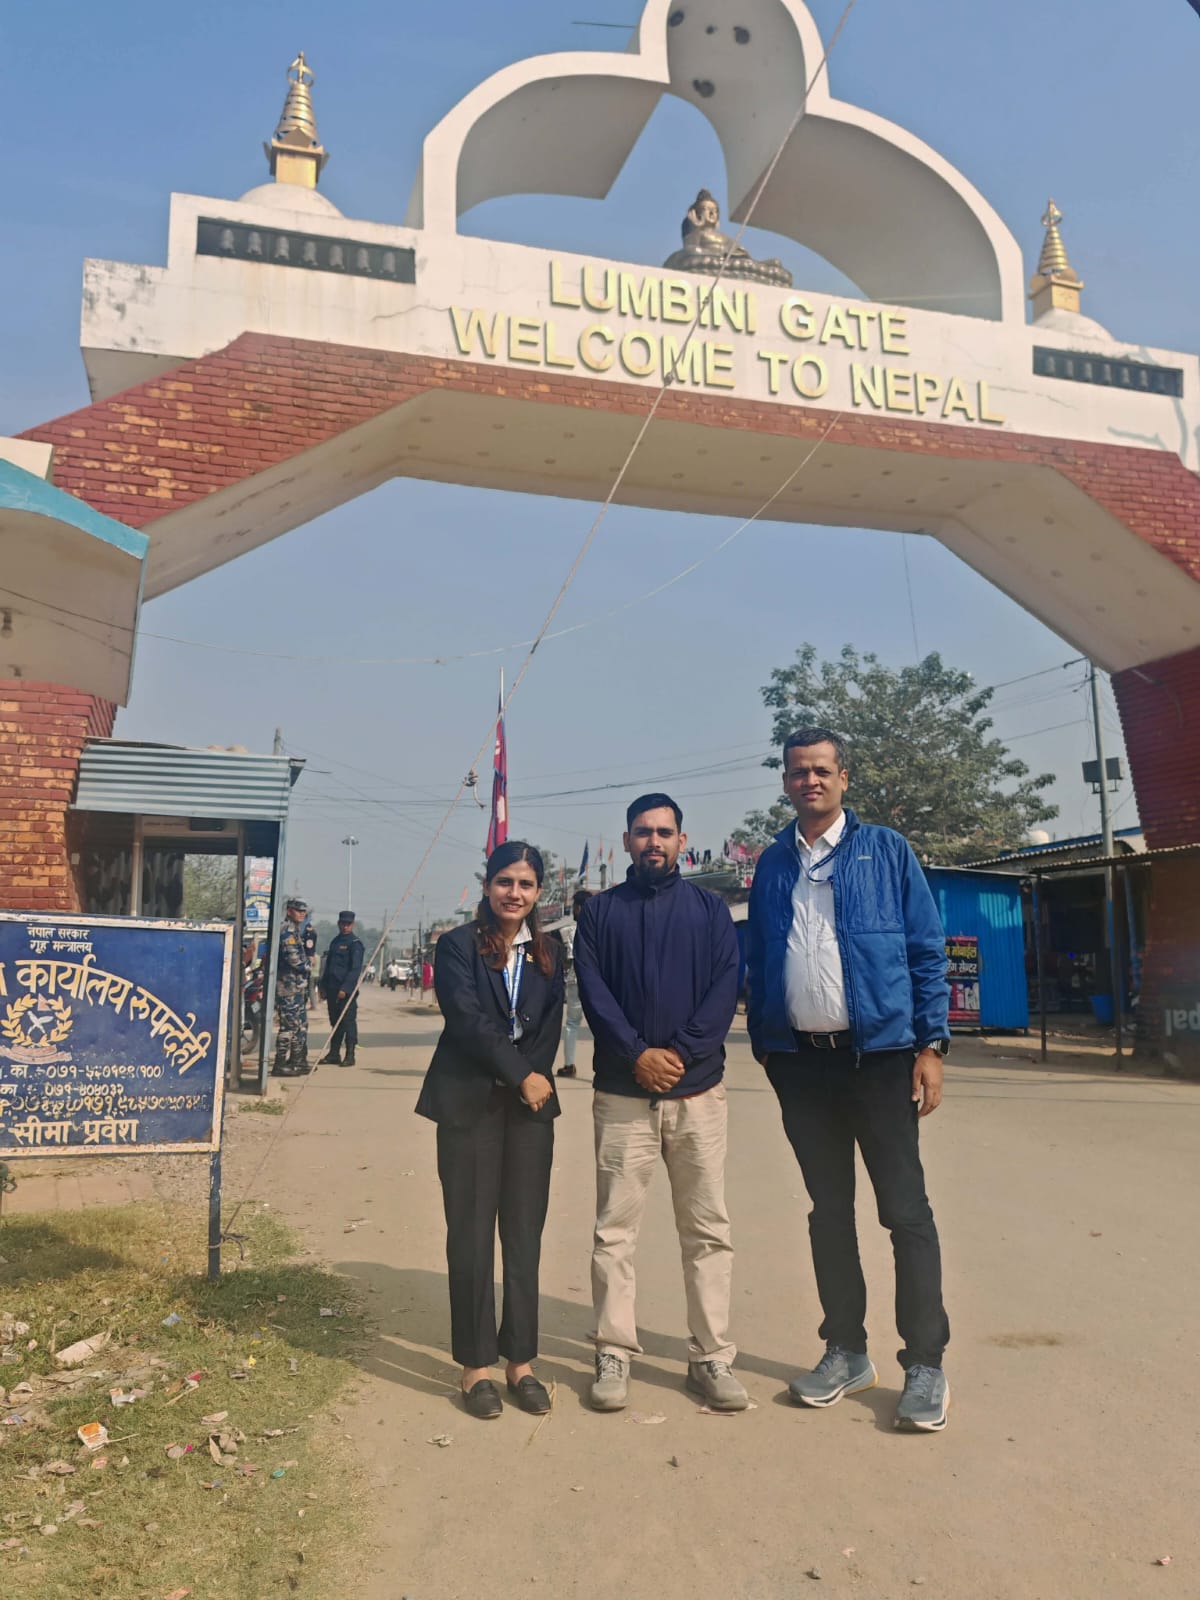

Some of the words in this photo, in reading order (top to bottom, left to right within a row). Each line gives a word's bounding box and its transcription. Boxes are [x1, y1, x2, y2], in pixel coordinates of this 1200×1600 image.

[550, 260, 756, 334] LUMBINI
[779, 296, 911, 355] GATE
[449, 305, 736, 390] WELCOME
[757, 350, 830, 399] TO
[850, 362, 1007, 424] NEPAL
[58, 928, 90, 941] सरकार
[15, 953, 134, 1015] कार्यालय
[9, 1115, 72, 1145] सीमा
[82, 1115, 139, 1144] प्रवेश
